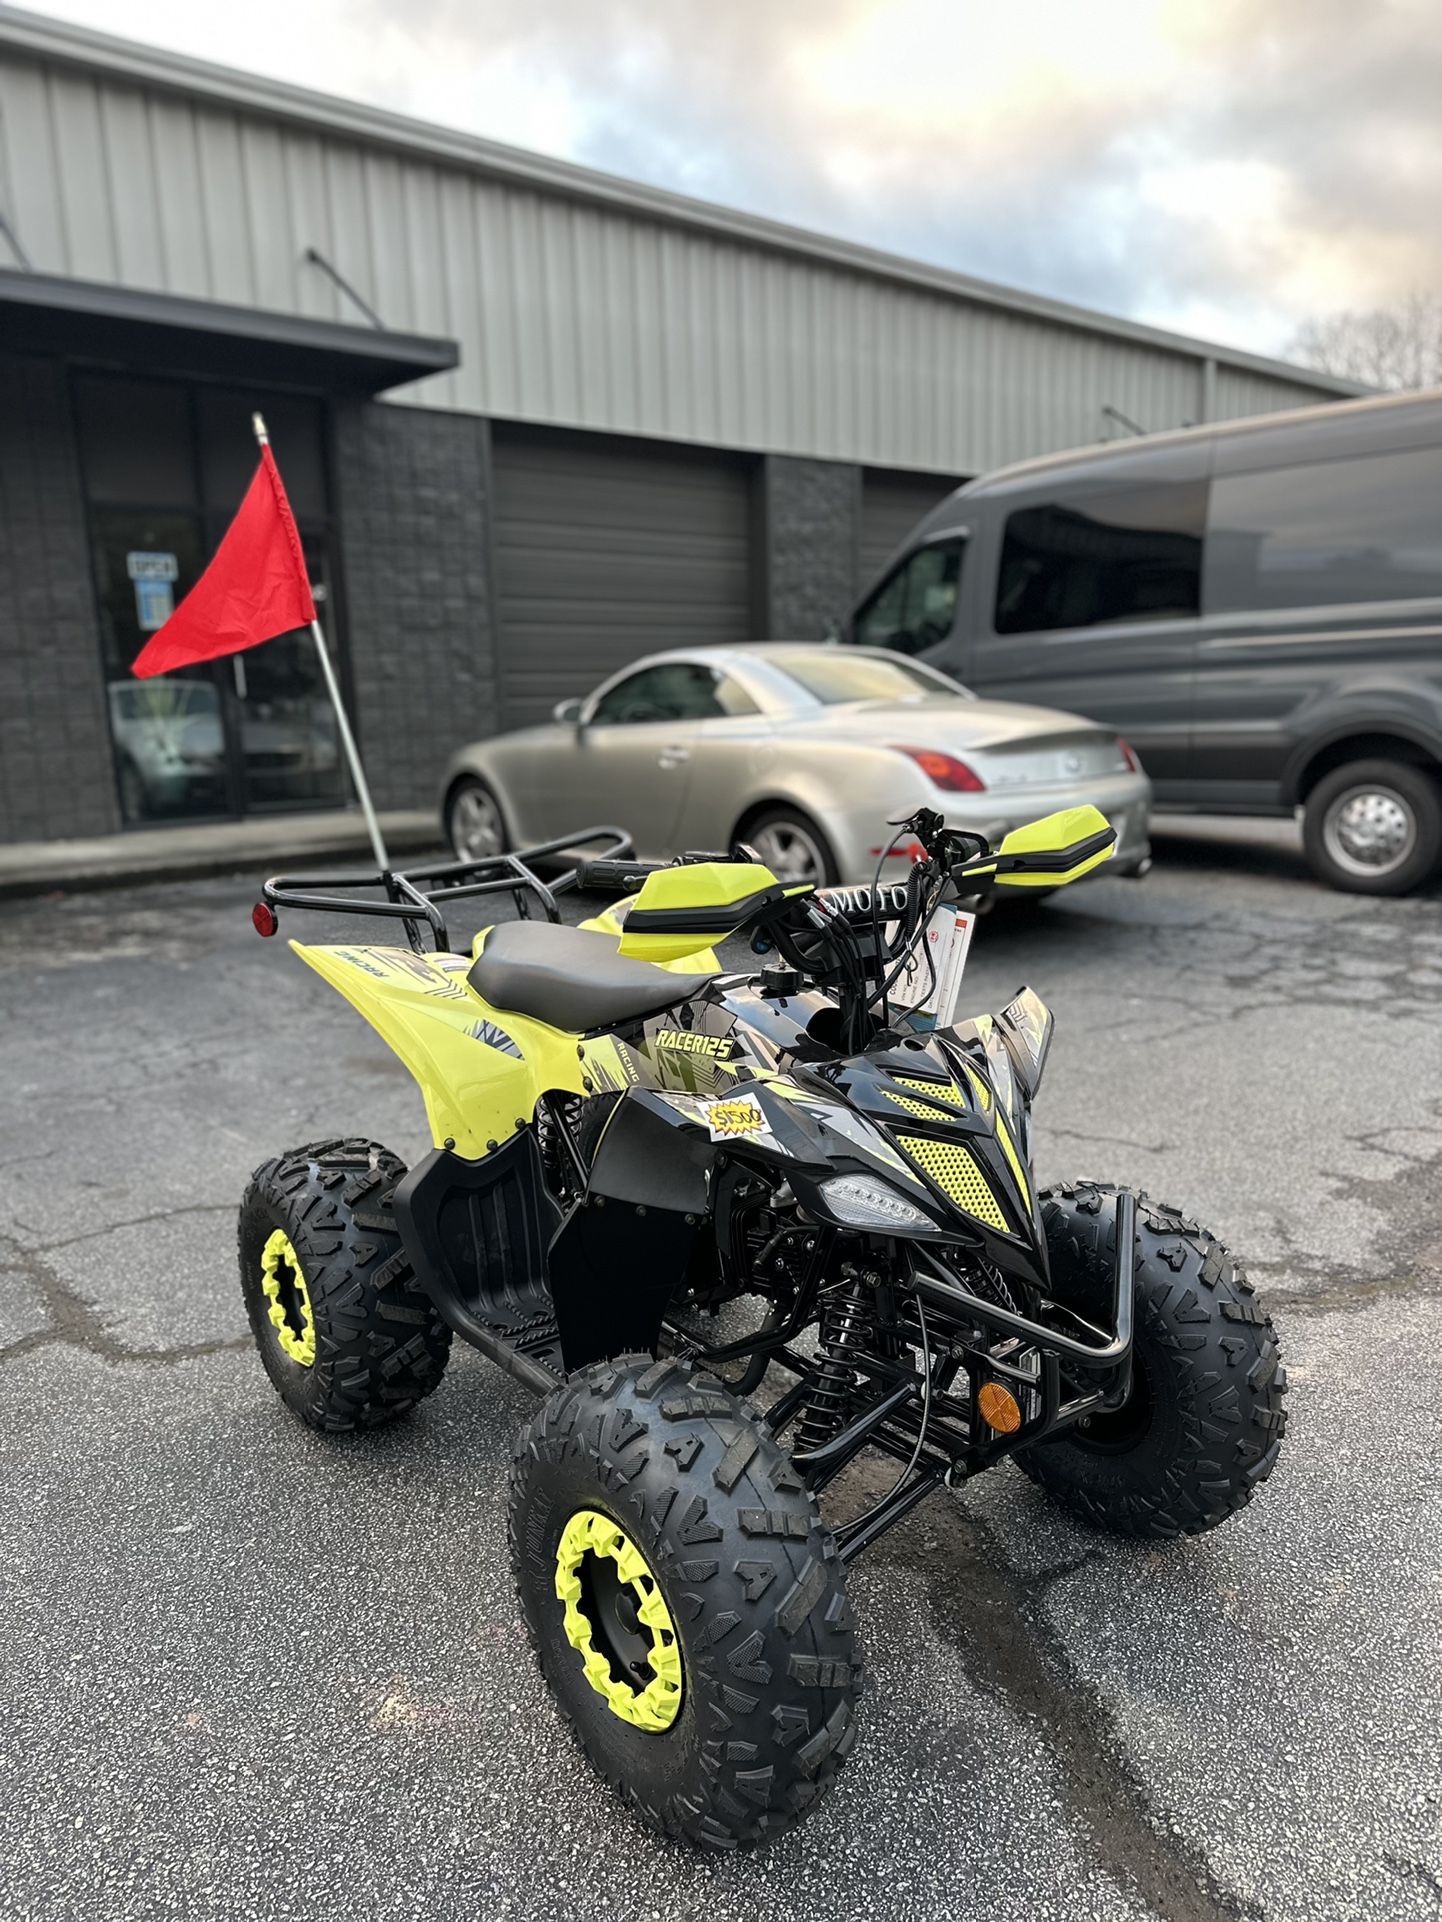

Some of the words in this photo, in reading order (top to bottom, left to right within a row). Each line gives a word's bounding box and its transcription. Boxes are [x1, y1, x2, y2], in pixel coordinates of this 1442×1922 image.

[827, 886, 908, 911] MOTO
[655, 1029, 735, 1059] RACER125
[617, 1043, 640, 1082] RACING
[715, 1108, 762, 1127] $1500
